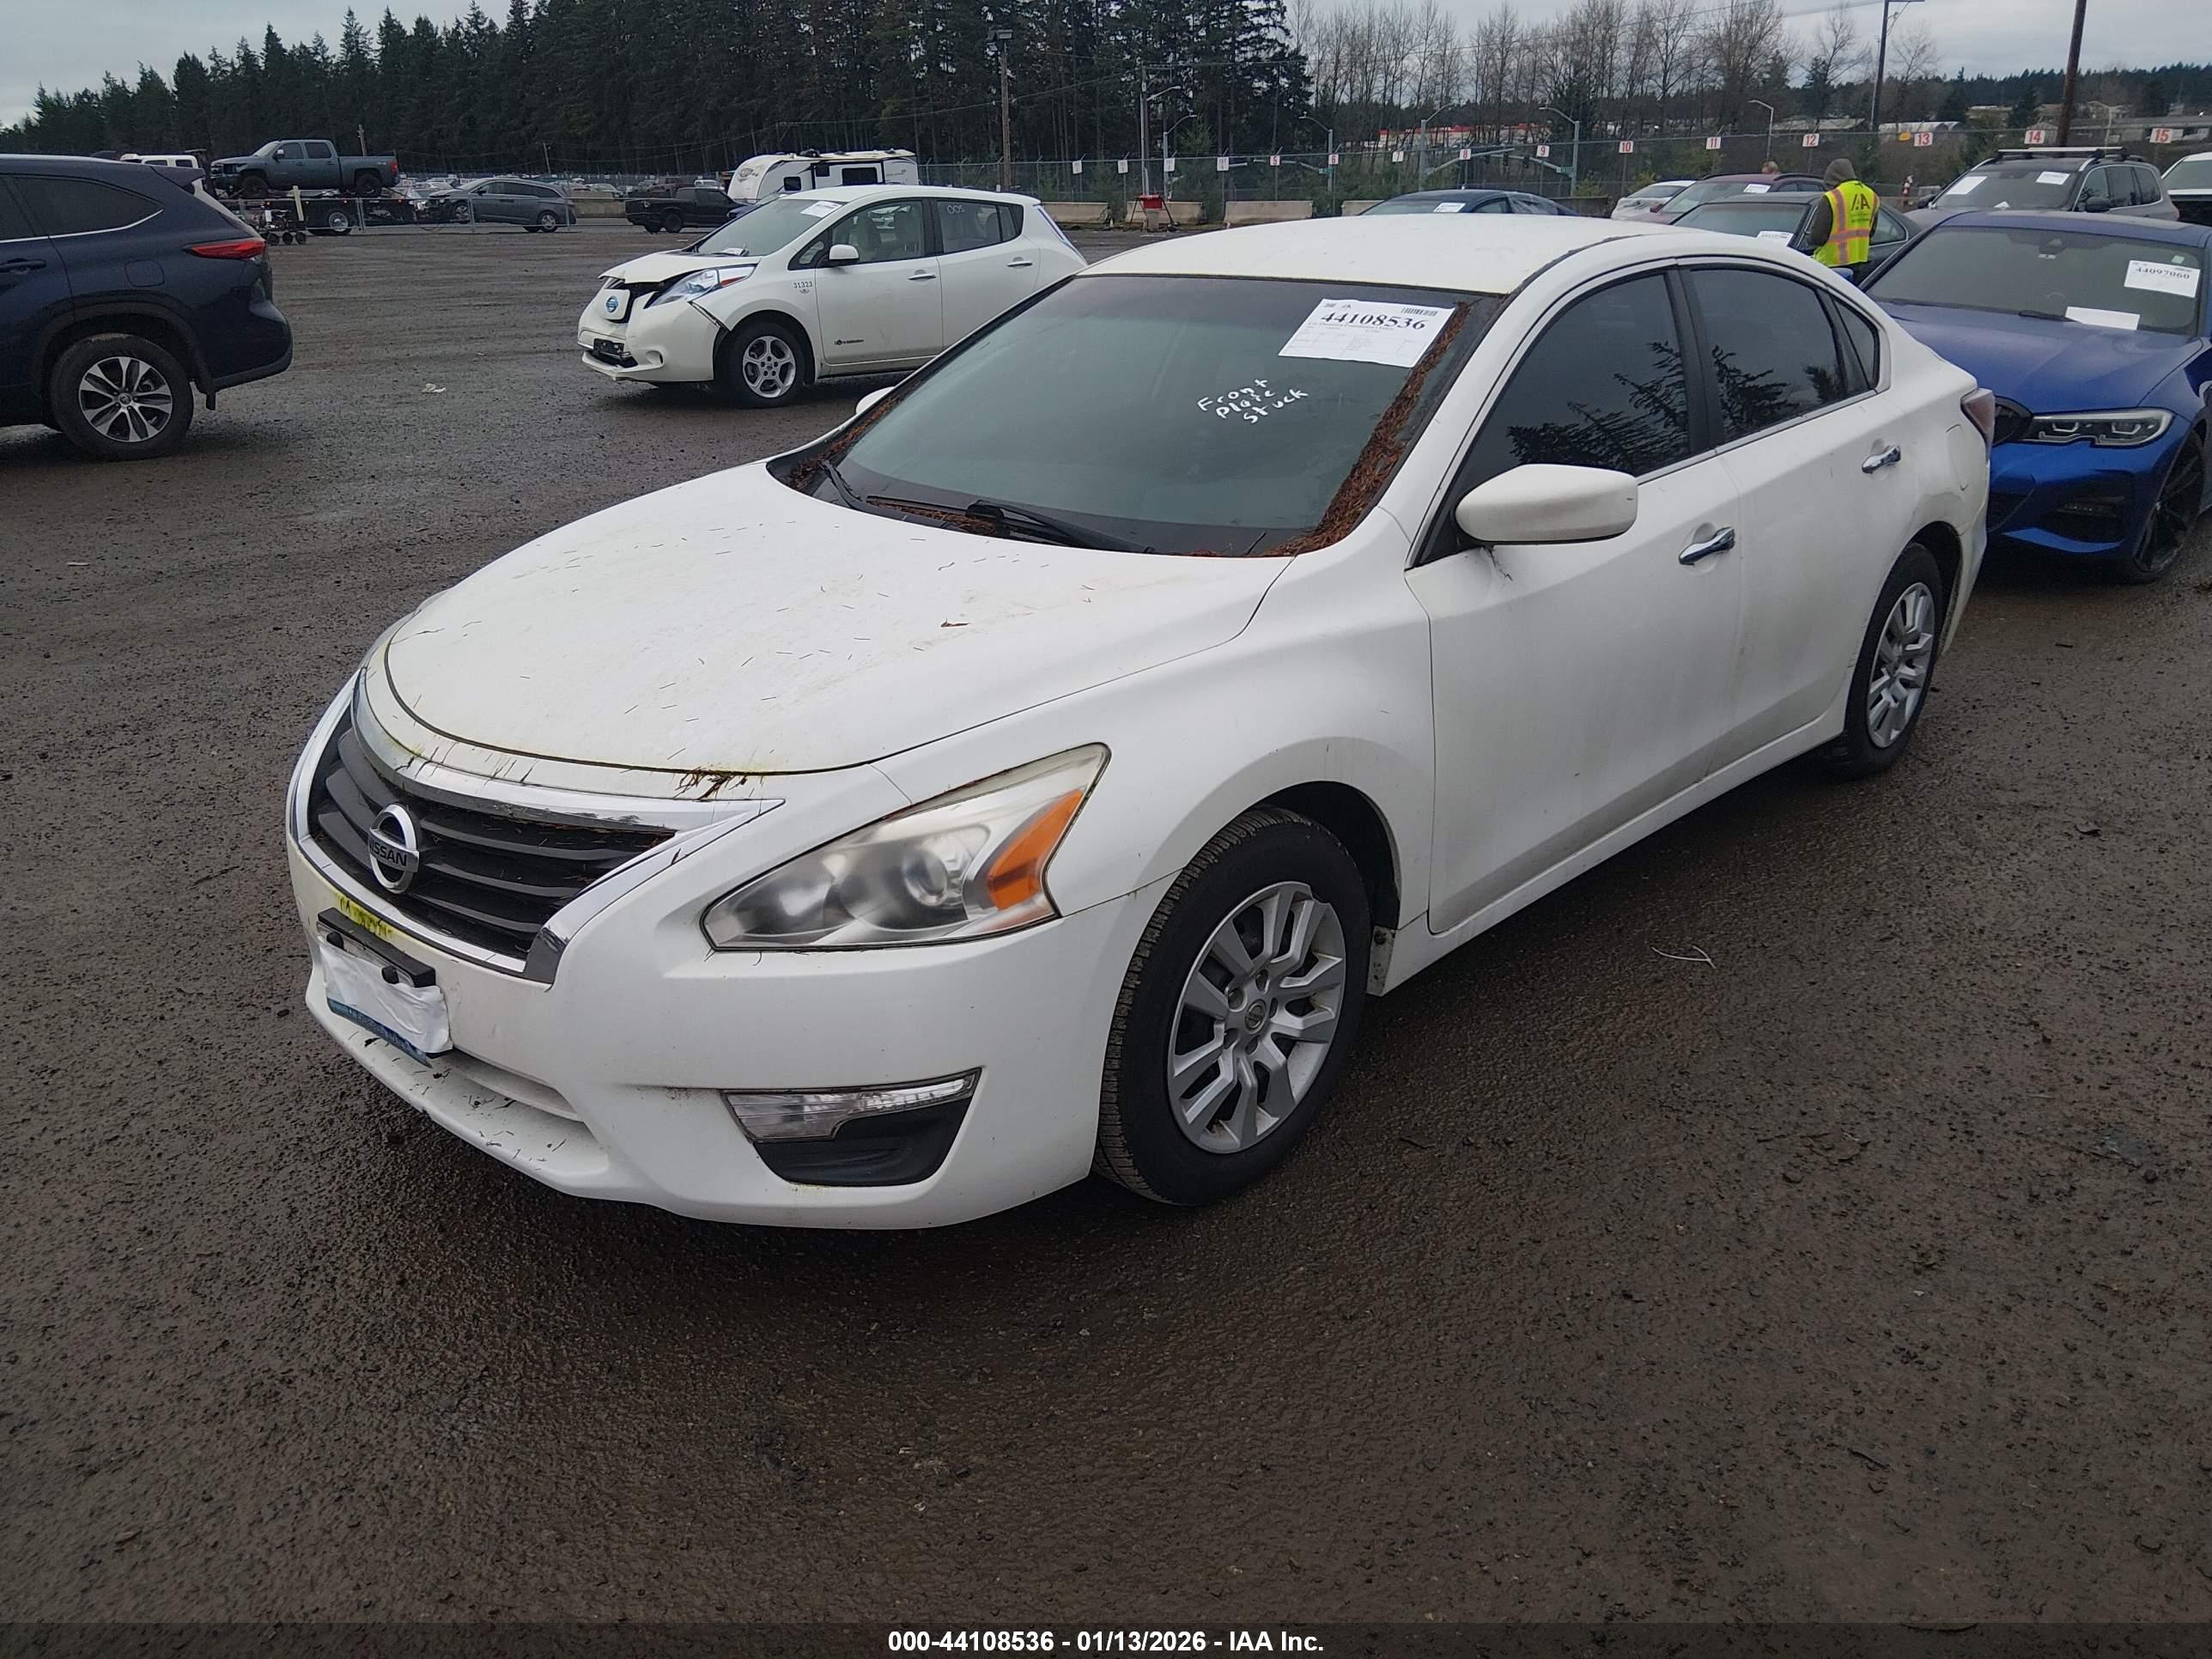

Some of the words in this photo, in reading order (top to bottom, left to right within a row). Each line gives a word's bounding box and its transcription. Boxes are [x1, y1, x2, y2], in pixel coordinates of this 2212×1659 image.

[1806, 135, 1816, 146] 12
[1917, 132, 1930, 144] 13
[2029, 131, 2042, 143] 14
[2155, 130, 2169, 143] 15
[1621, 143, 1632, 152] 10
[1710, 137, 1718, 149] 11
[1462, 149, 1468, 159] 8
[1540, 146, 1547, 155] 9
[1273, 155, 1278, 165] 5
[1332, 155, 1338, 164] 6
[793, 281, 813, 289] 31323
[1321, 312, 1430, 331] 44108536
[1197, 379, 1268, 411] Front
